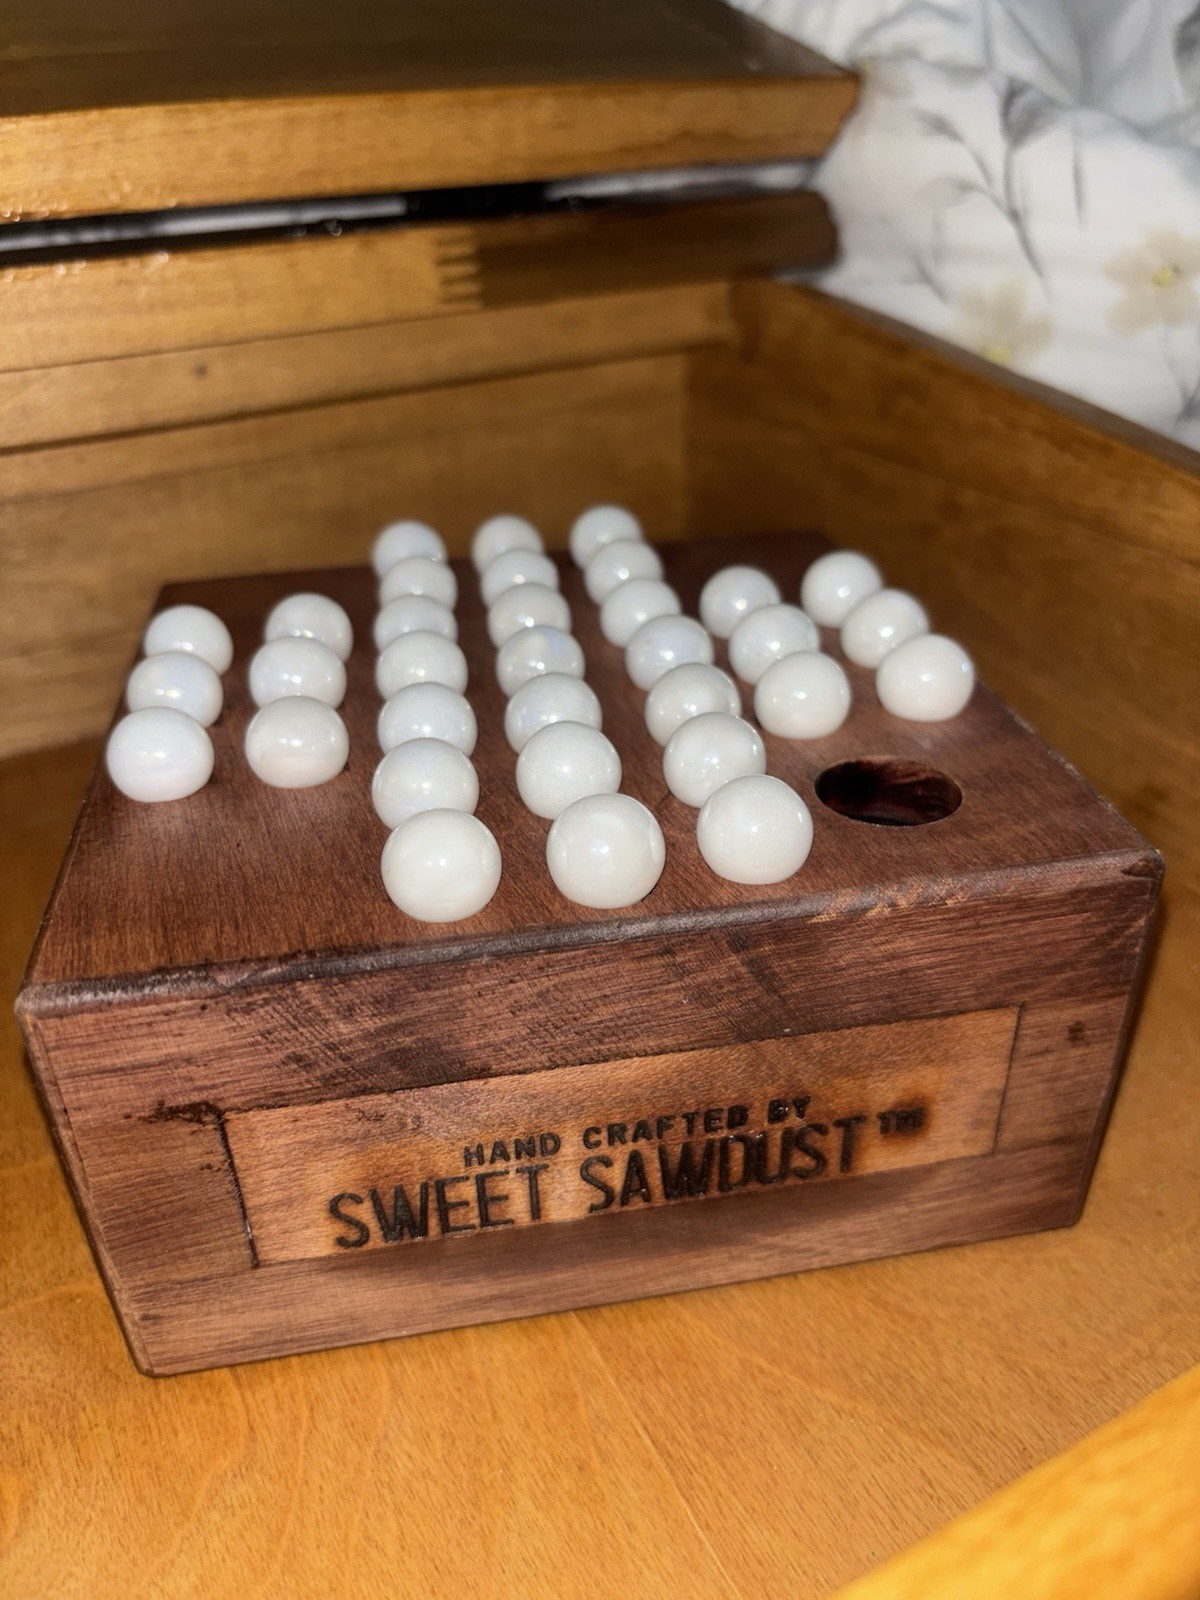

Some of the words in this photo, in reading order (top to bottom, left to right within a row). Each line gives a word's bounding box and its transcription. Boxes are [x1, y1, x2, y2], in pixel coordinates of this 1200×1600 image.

[464, 1133, 561, 1166] HAND
[582, 1107, 748, 1149] CRAFTED
[769, 1096, 811, 1124] BY
[329, 1164, 550, 1248] SWEET
[581, 1116, 866, 1212] SAWDUST
